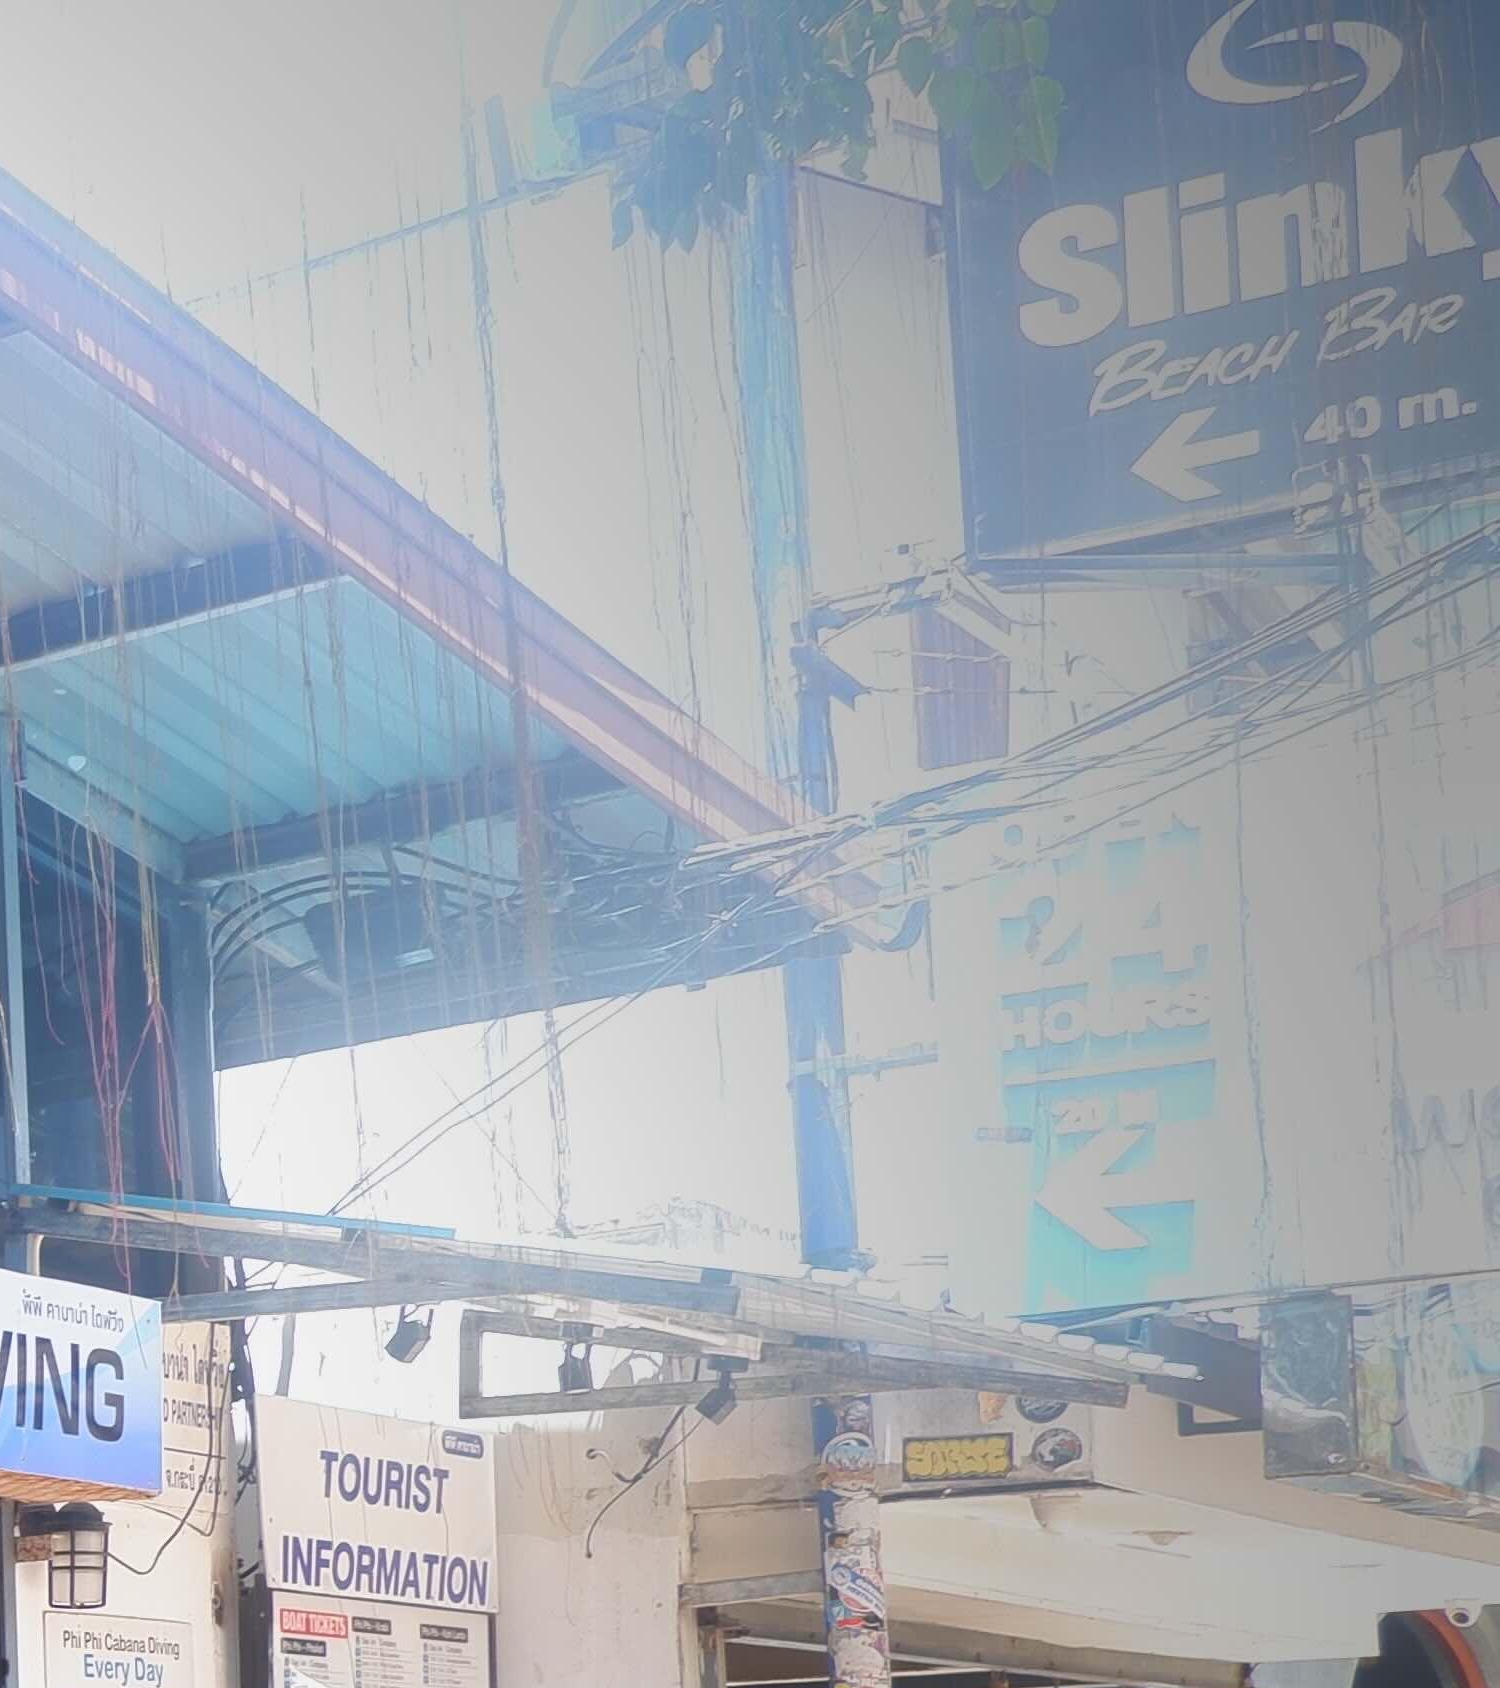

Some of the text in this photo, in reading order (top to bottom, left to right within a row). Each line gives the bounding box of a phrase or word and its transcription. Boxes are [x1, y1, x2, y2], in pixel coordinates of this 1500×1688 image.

[1304, 387, 1477, 443] 40 m.
[320, 1450, 449, 1514] TOURIST
[283, 1535, 488, 1606] INFORMATION
[63, 1628, 180, 1660] Phi Phi Cabana Diving
[282, 1610, 306, 1632] BOAT
[309, 1612, 347, 1636] TICKETS
[84, 1654, 164, 1688] Every Day
